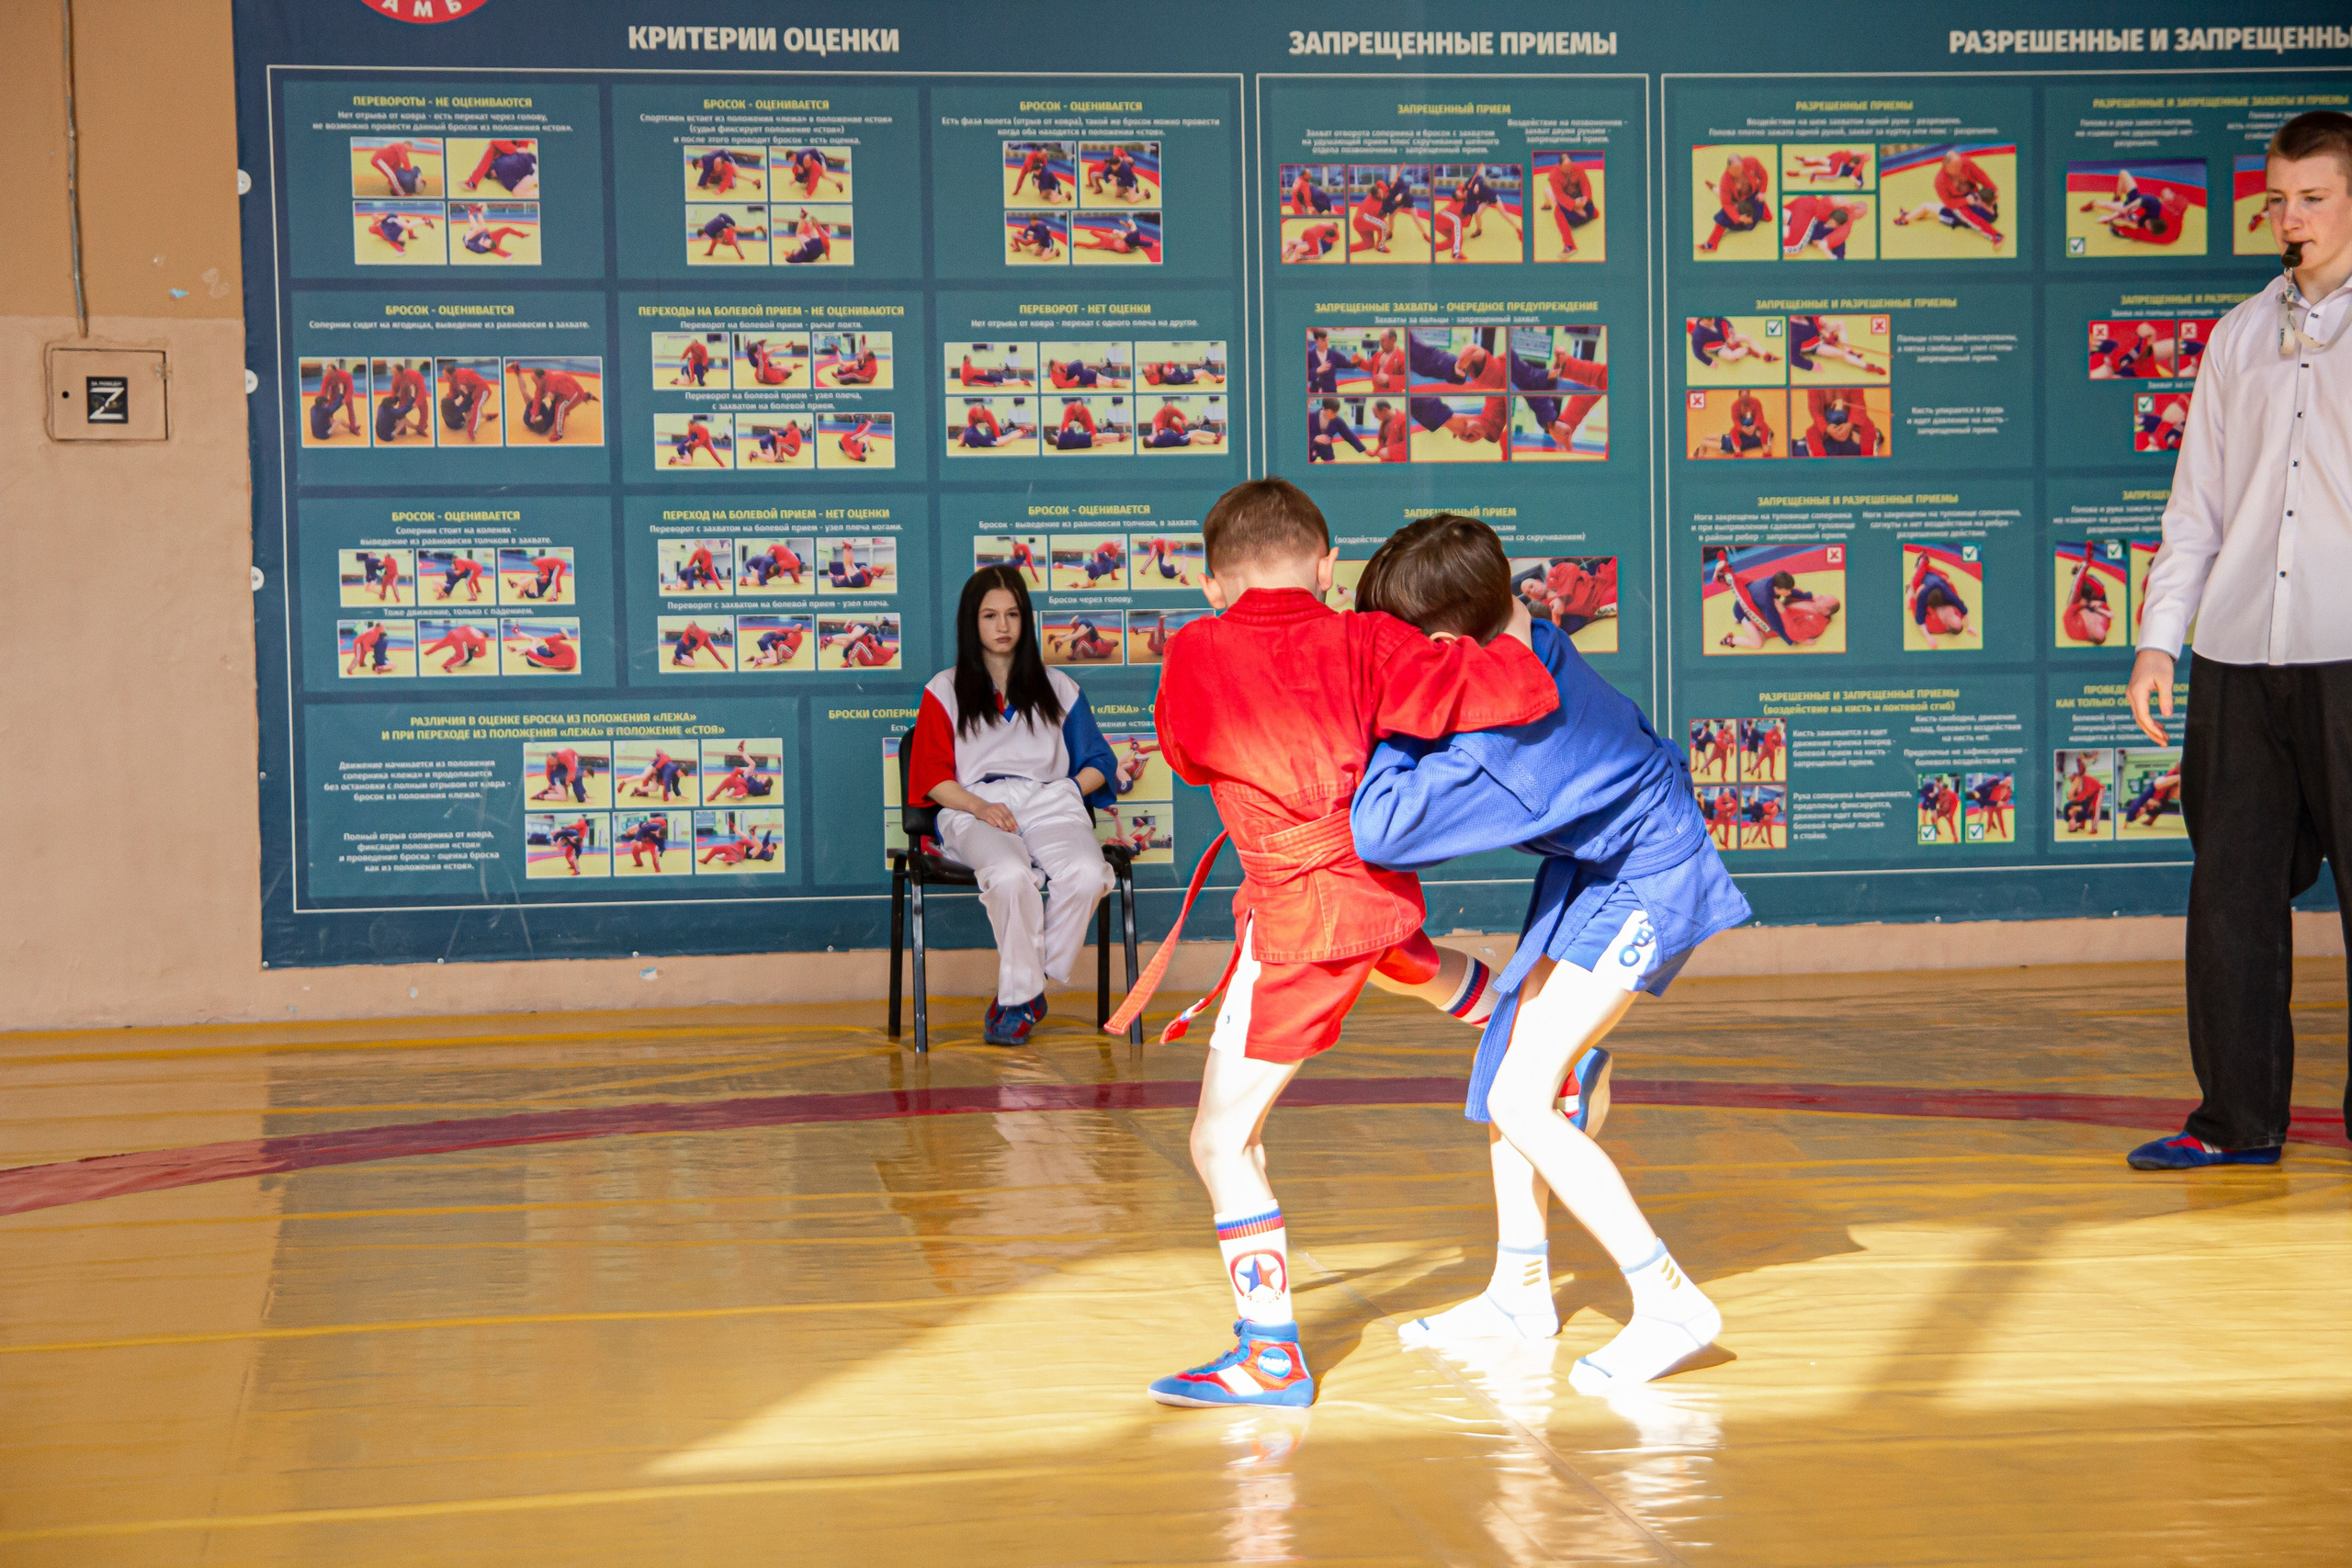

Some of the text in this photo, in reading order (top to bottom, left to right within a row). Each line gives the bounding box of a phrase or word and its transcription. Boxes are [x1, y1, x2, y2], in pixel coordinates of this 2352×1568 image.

[628, 26, 899, 56] КРИТЕРИИ ОЦЕНКИ
[1288, 31, 1616, 60] ЗАПРЕЩЕННЫЕ ПРИЕМЫ
[1949, 28, 2143, 53] РАЗРЕШЕННЫЕ
[2149, 28, 2167, 51] И
[352, 96, 425, 106] ПЕРЕВОРОТЫ
[435, 96, 448, 107] НЕ
[451, 96, 532, 107] ОЦЕНИВАЮТСЯ
[703, 99, 745, 109] БРОСОК
[754, 99, 829, 109] ОЦЕНИВАЕТСЯ
[1019, 101, 1060, 110] БРОСОК
[1069, 101, 1142, 111] ОЦЕНИВАЕТСЯ
[1795, 100, 1913, 111] РАЗРЕШЕННЫЕ ПРИЕМЫ
[1397, 103, 1510, 114] ЗАПРЕЩЕННЫЙ ПРИЕМ
[1019, 304, 1078, 313] ПЕРЕВОРОТ
[1087, 304, 1106, 313] НЕТ
[1108, 304, 1151, 314] ОЦЕНКИ
[1315, 302, 1389, 312] ЗАПРЕЩЕННЫЕ
[1392, 302, 1438, 311] ЗАХВАТЫ
[1446, 301, 1504, 312] ОЧЕРЕДНОЕ
[1506, 301, 1598, 311] ПРЕДУПРЕЖДЕНИЕ
[1755, 298, 1957, 310] ЗАПРЕЩЕННЫЕ И РАЗРЕШЕННЫЕ ПРИЕМЫ
[385, 305, 428, 314] БРОСОК
[437, 305, 514, 315] ОЦЕНИВАЕТСЯ
[638, 306, 695, 317] ПЕРЕХОДЫ
[696, 306, 711, 315] НА
[713, 305, 763, 315] БОЛЕВОЙ
[764, 306, 802, 315] ПРИЕМ
[810, 306, 824, 315] НЕ
[826, 306, 904, 316] ОЦЕНИВАЮТСЯ
[1757, 493, 1958, 506] ЗАПРЕЩЕННЫЕ И РАЗРЕШЕННЫЕ ПРИЕМЫ
[662, 510, 710, 521] ПЕРЕХОД
[712, 510, 727, 519] НА
[728, 508, 777, 519] БОЛЕВОЙ
[779, 509, 816, 518] ПРИЕМ
[825, 509, 844, 518] НЕТ
[846, 508, 889, 519] ОЦЕНКИ
[1027, 505, 1069, 515] БРОСОК
[1078, 504, 1150, 515] ОЦЕНИВАЕТСЯ
[1482, 507, 1517, 516] ПРИЕМ
[391, 512, 435, 521] БРОСОК
[444, 511, 520, 521] ОЦЕНИВАЕТСЯ
[395, 526, 436, 535] Соперник
[1526, 534, 1585, 542] скручиванием)
[1048, 595, 1077, 604] Бросок
[1758, 688, 1959, 702] РАЗРЕШЕННЫЕ И ЗАПРЕЩЕННЫЕ ПРИЕМЫ
[1097, 705, 1139, 714] «ЛЕЖА»
[1762, 704, 1828, 715] (воздействие
[1829, 705, 1842, 713] на
[1882, 703, 1928, 711] локтевой
[1929, 700, 1955, 711] сгиб)
[410, 712, 696, 726] РАЗЛИЧИЯ В ОЦЕНКЕ БРОСКА ИЗ ПОЛОЖЕНИЯ «ЛЕЖА»
[829, 708, 920, 719] БРОСКИ СОПЕРНИ
[381, 725, 725, 740] И ПРИ ПЕРЕХОДЕ ИЗ ПОЛОЖЕНИЯ «ЛЕЖА» В ПОЛОЖЕНИЕ «СТОЯ»
